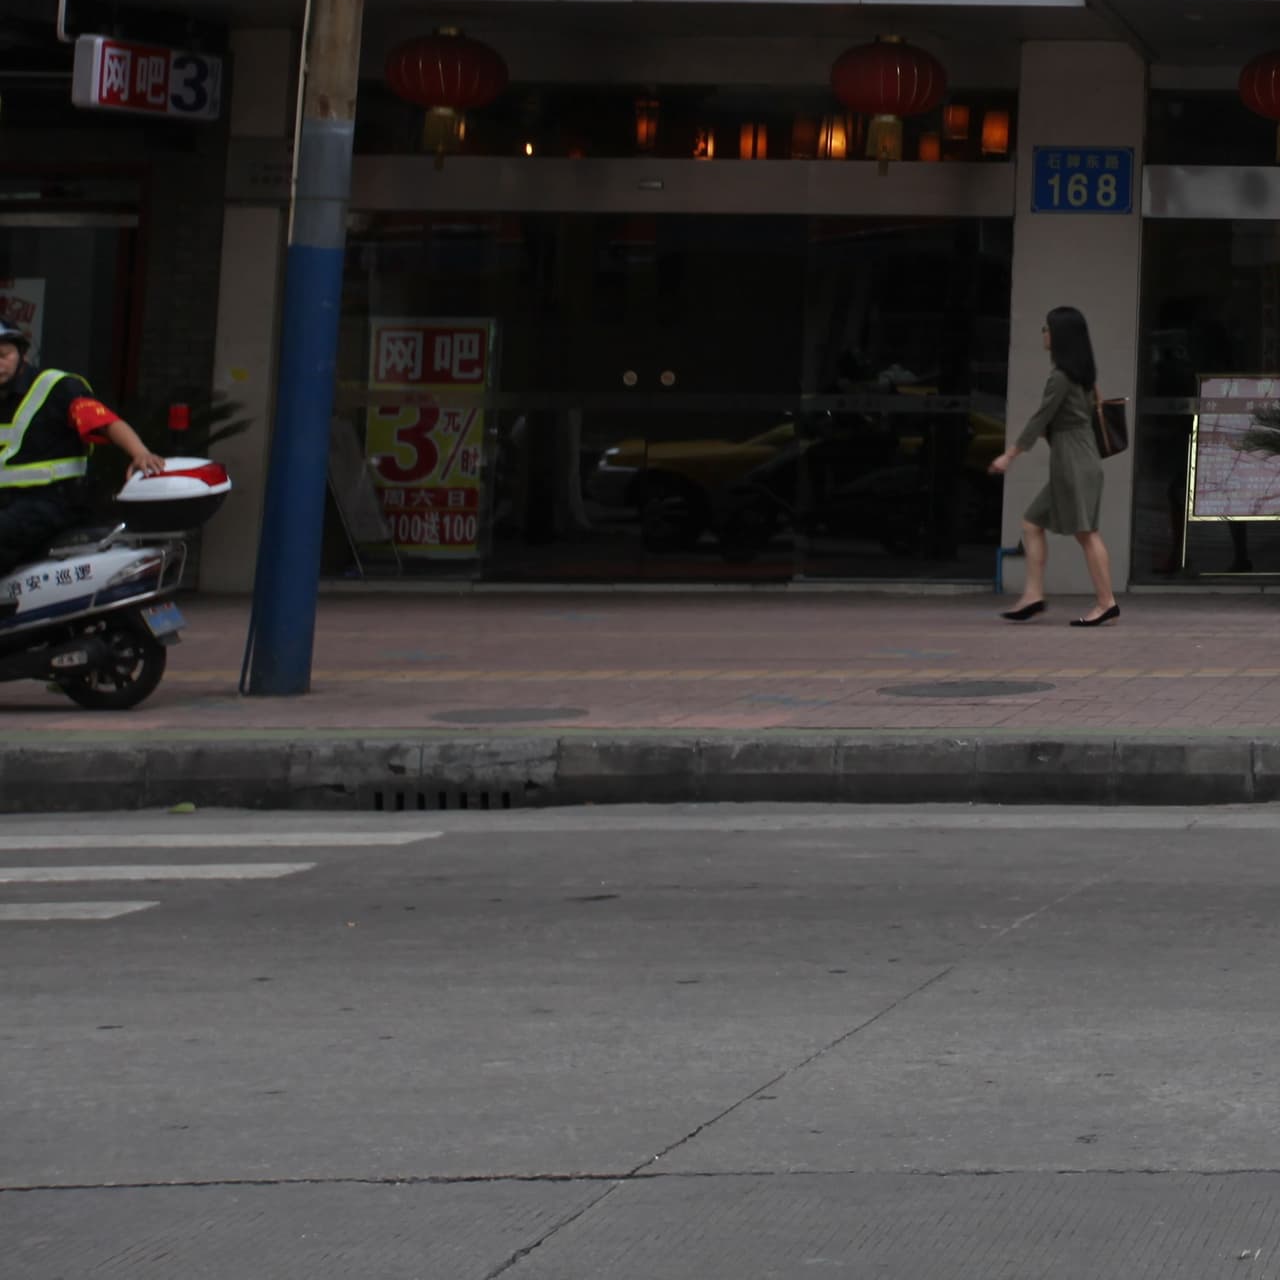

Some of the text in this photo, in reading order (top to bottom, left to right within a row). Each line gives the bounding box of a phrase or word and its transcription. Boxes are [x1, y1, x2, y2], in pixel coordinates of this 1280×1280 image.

[103, 47, 165, 105] 网吧
[1047, 173, 1117, 207] 168
[379, 330, 483, 381] 网吧
